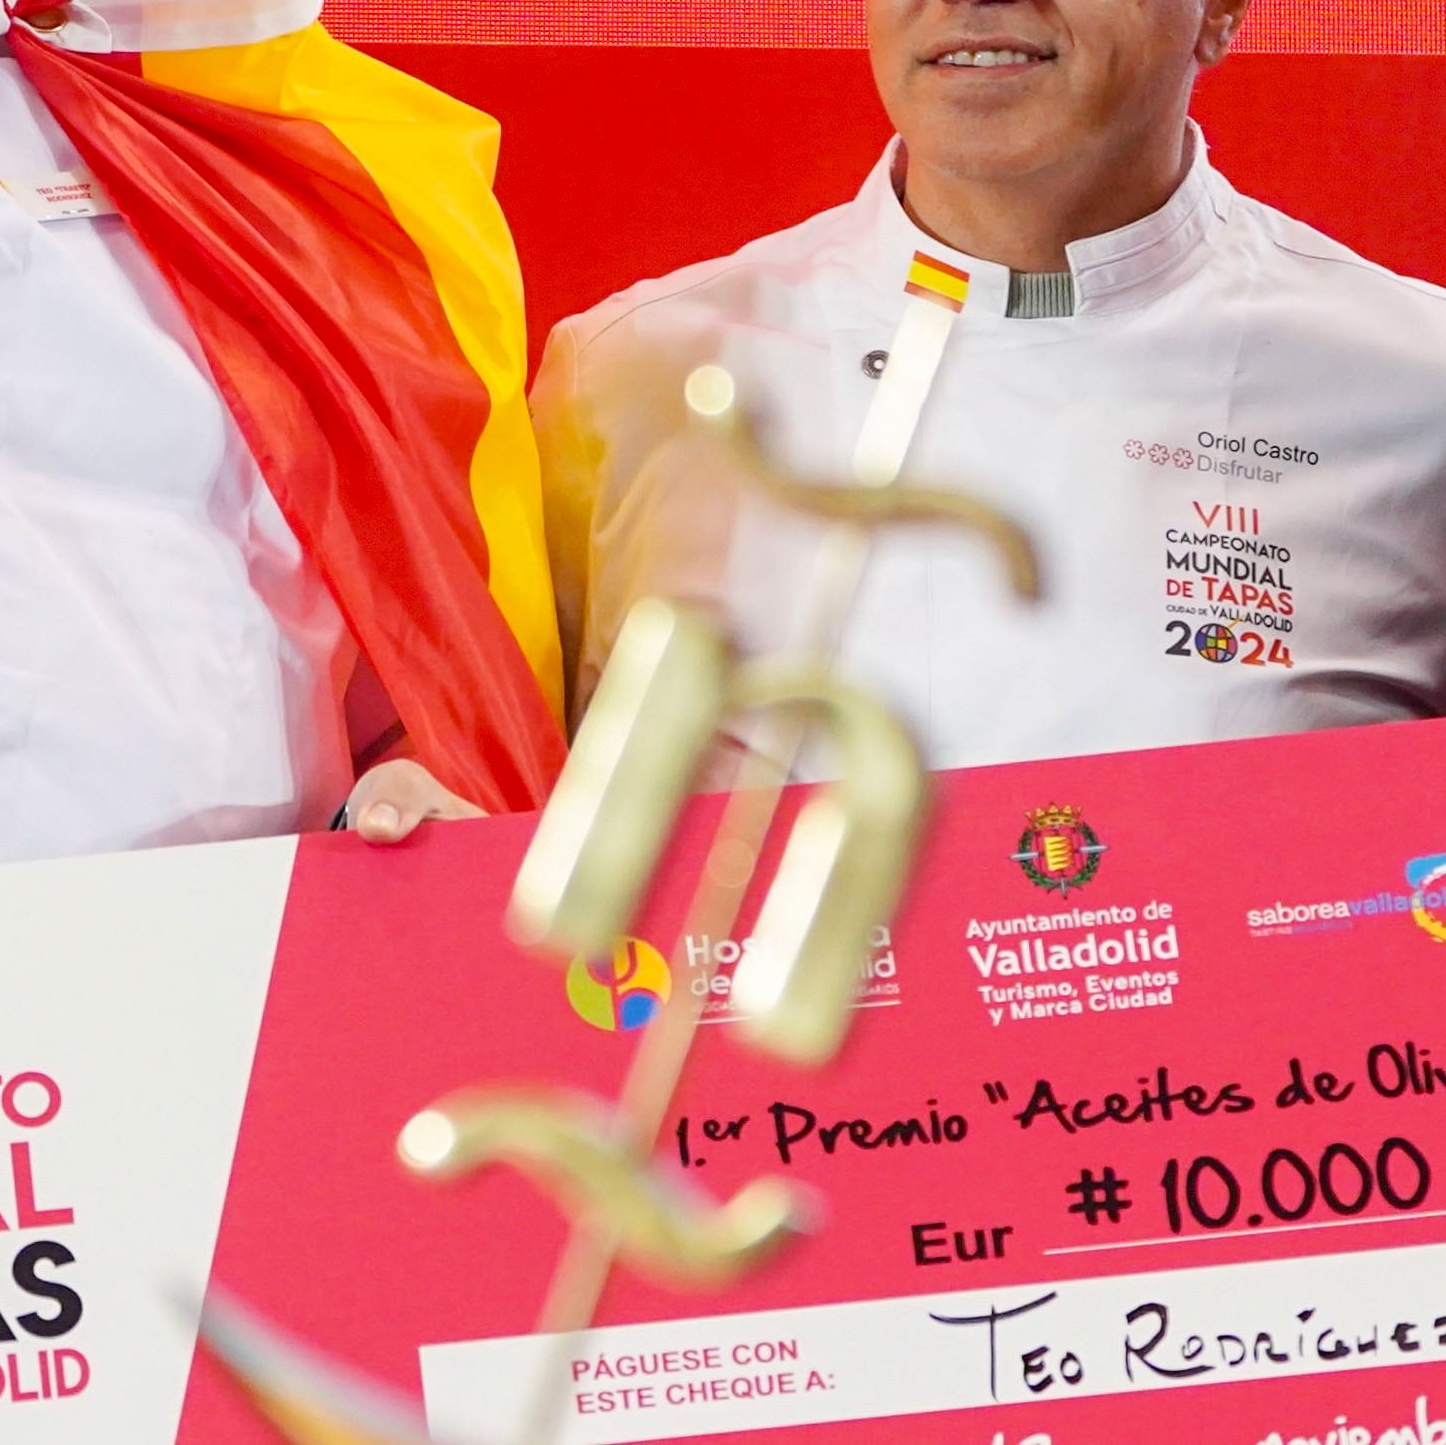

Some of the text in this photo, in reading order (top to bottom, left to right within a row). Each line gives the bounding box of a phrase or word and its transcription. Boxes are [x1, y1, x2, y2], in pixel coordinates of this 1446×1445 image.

[1197, 431, 1320, 466] Oriol Castro
[1197, 455, 1284, 485] Disfrutar
[1192, 500, 1259, 536] VIII
[1165, 529, 1292, 563] CAMPEONATO
[1165, 550, 1293, 592] MUNDIAL
[1165, 576, 1294, 616] DE TAPAS
[1165, 604, 1294, 633] CIUDAD DE VALLADOLID
[965, 899, 1173, 940] Ayuntamiento de
[967, 925, 1180, 980] Valladolid
[978, 970, 1180, 1005] Turismo, Eventos
[989, 987, 1174, 1026] y Marca Ciudad
[768, 1099, 971, 1165] Premio
[982, 1066, 1256, 1134] "Aceites
[1275, 1057, 1355, 1110] de
[911, 1221, 1014, 1267] Eur
[1160, 1136, 1432, 1235] 10.000
[571, 1339, 799, 1383] PÁGUESE CON
[576, 1369, 837, 1416] ESTE CHEQUE A:
